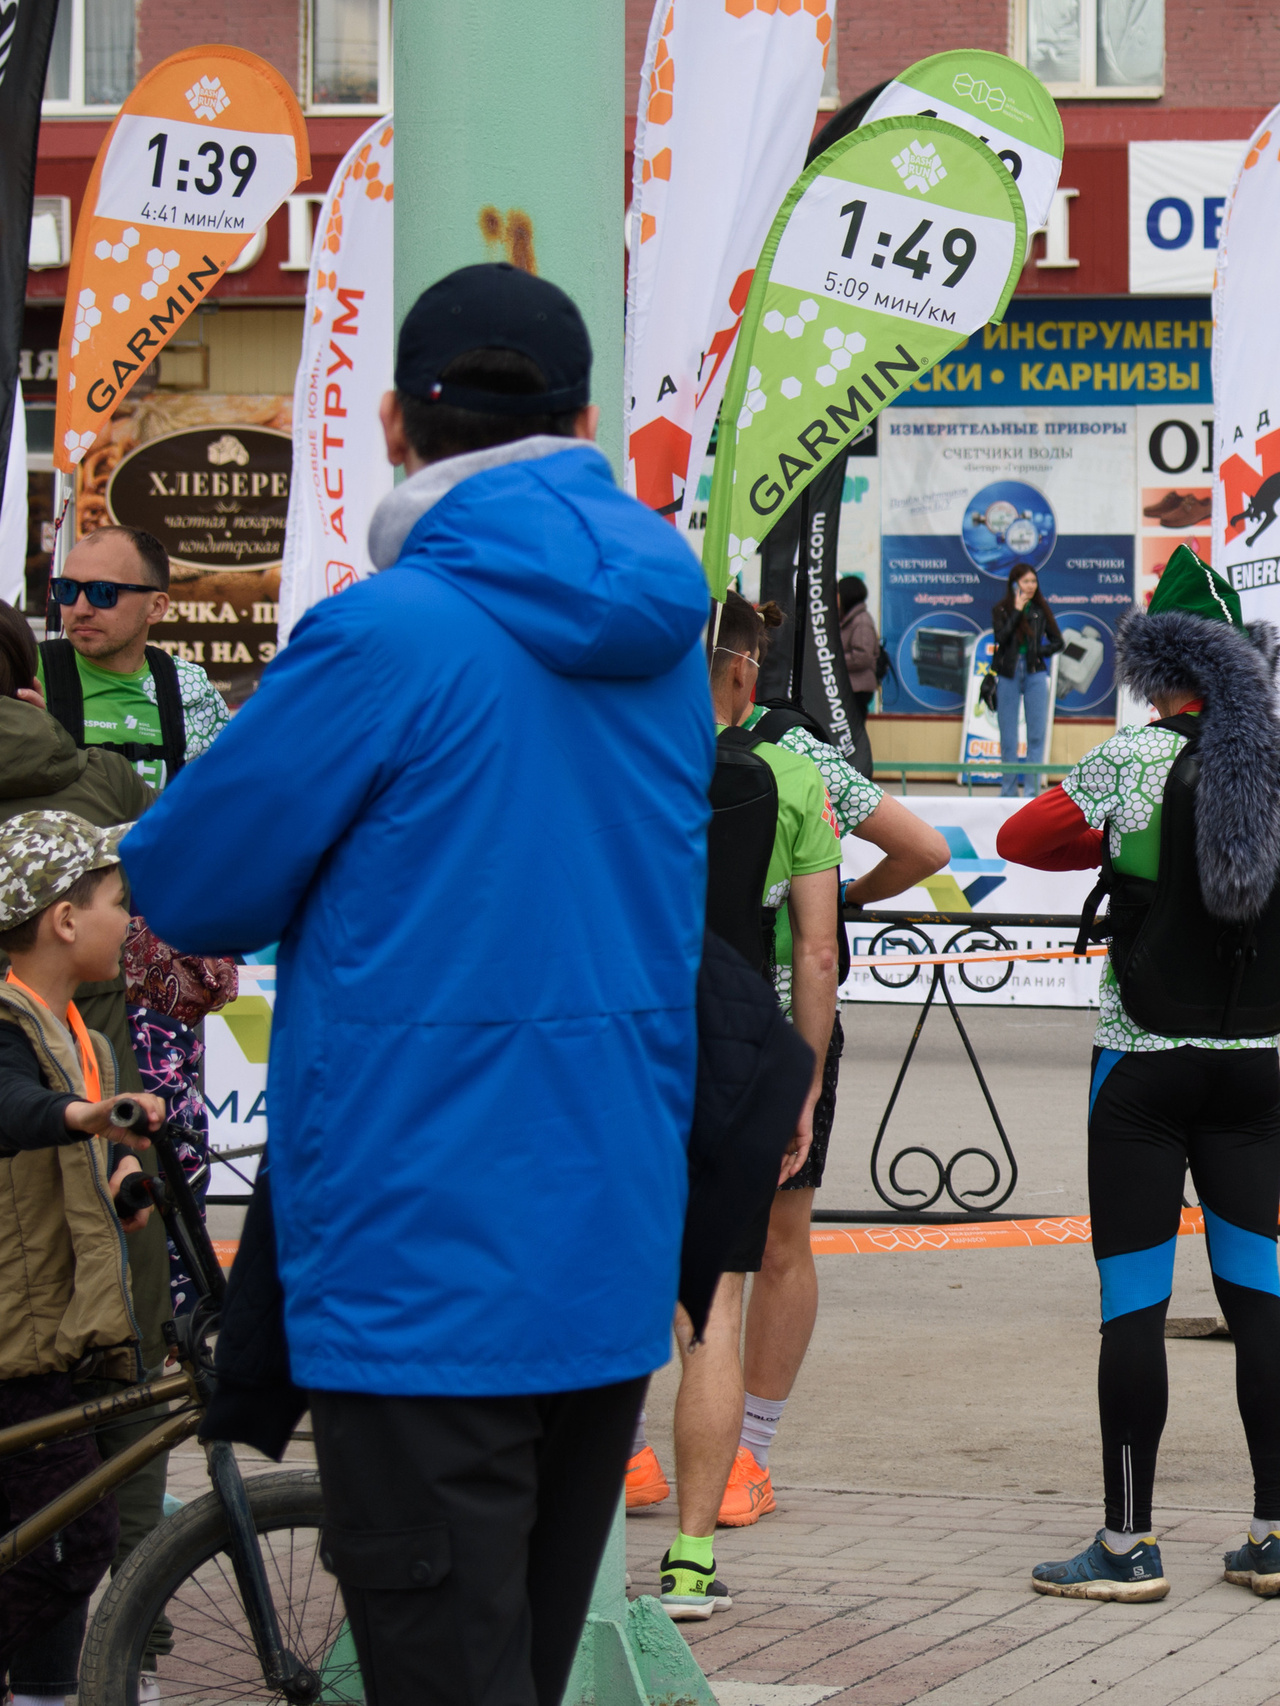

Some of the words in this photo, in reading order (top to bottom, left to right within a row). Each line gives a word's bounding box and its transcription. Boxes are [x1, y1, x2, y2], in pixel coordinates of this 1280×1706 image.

[198, 96, 217, 107] RUN
[147, 132, 257, 198] 1:39
[908, 164, 931, 179] RUN
[909, 155, 932, 168] BASH
[140, 201, 178, 224] 4:41
[183, 208, 245, 230] мин/км
[838, 199, 977, 289] 1:49
[824, 271, 870, 301] 5:09
[873, 291, 957, 325] мин/км
[86, 255, 220, 412] GARMIN
[983, 321, 1214, 350] ИНСТРУМЕНТ
[1020, 362, 1200, 391] КАРНИЗЫ
[322, 287, 365, 544] АСТРУМ
[749, 344, 920, 517] GARMIN
[890, 422, 1038, 436] ИЗМЕРИТЕЛЬНЫЕ
[1045, 422, 1127, 436] ПРИБОРЫ
[943, 447, 1023, 461] СЧЕТЧИКИ
[1029, 447, 1073, 461] ВОДЫ
[164, 515, 227, 529] частная
[178, 532, 280, 560] кондитерская
[889, 558, 947, 570] СЧЕТЧИКИ
[1066, 558, 1125, 570] СЧЕТЧИКИ
[889, 573, 981, 585] ЭЛЕКТРИЧЕСТВА
[1097, 573, 1125, 585] ГАЗА
[211, 641, 253, 663] НА
